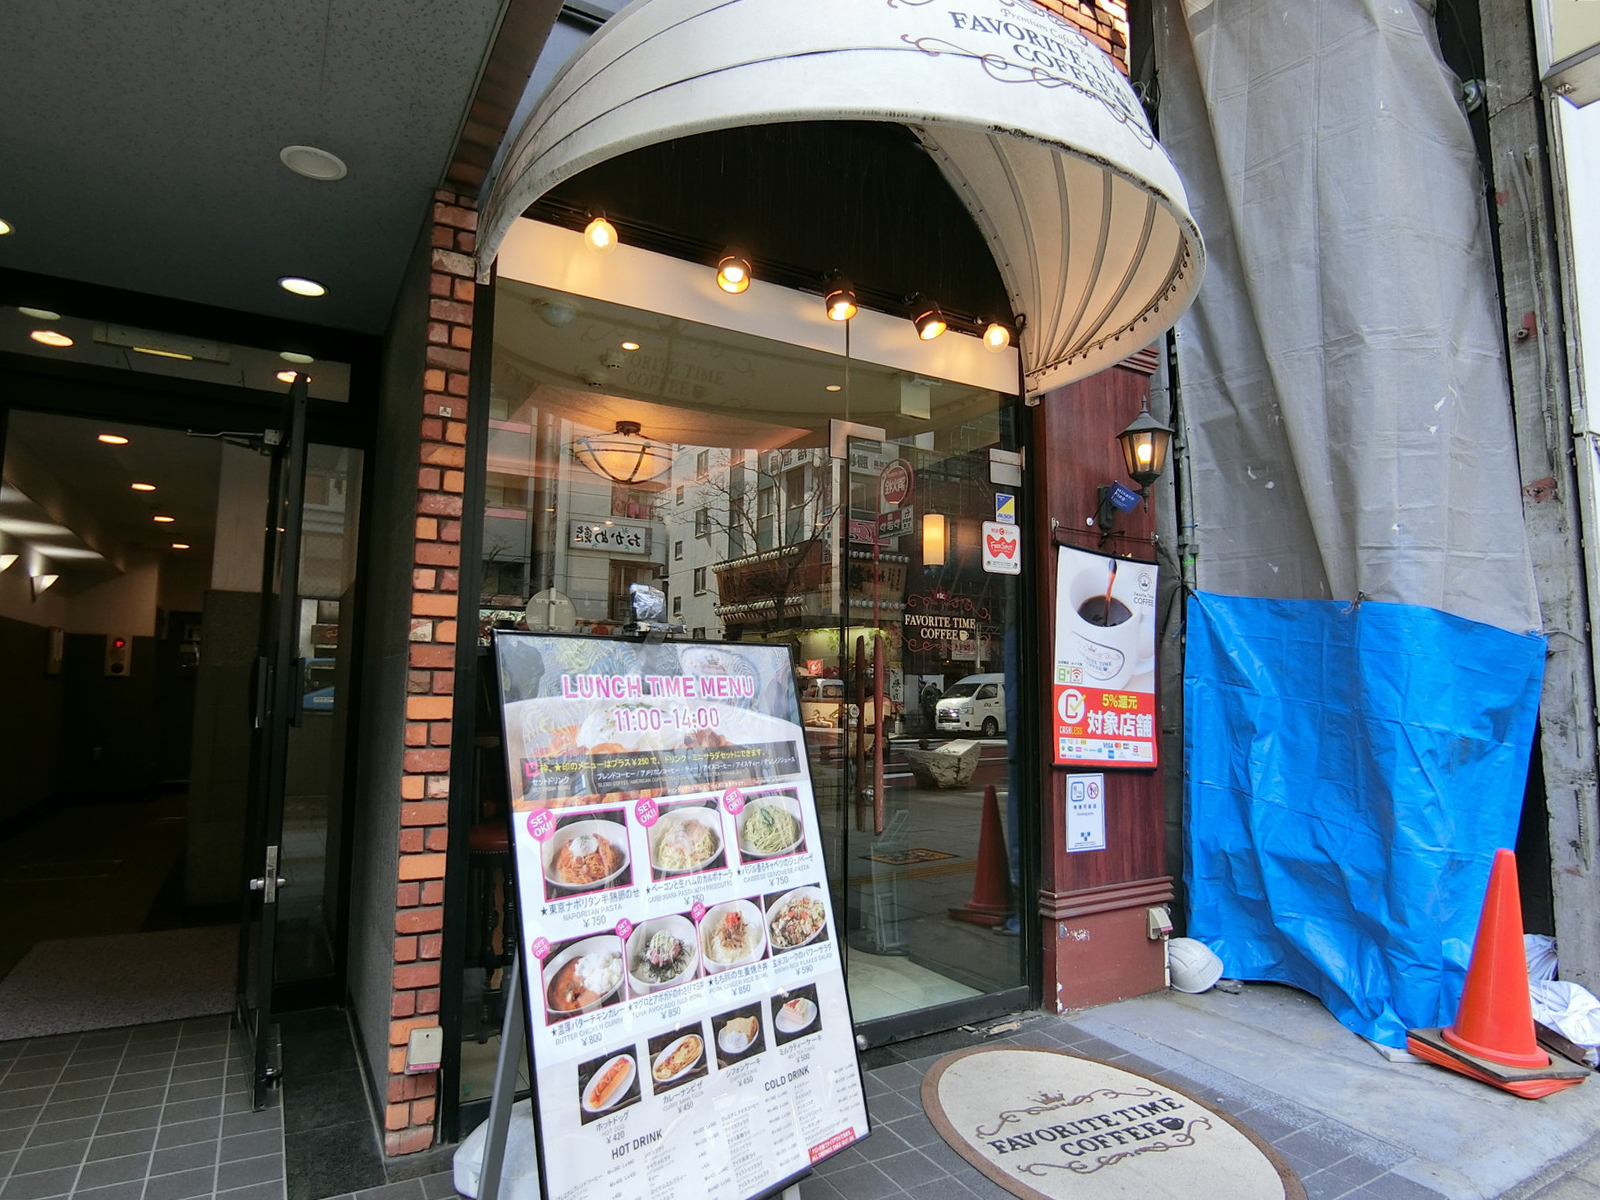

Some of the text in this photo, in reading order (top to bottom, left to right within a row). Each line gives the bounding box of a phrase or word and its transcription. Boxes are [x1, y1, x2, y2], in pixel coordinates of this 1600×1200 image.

[949, 11, 1086, 70] FAVORITE
[1013, 44, 1109, 97] COFFEE
[1134, 597, 1154, 607] COFFEE
[905, 614, 976, 630] FAVORITE TIME
[920, 627, 959, 640] COFFEE
[563, 675, 754, 698] LUNCH TIME MENU
[1102, 693, 1138, 709] 5%還元
[614, 707, 720, 732] 11:00-14:00
[1087, 710, 1153, 738] 対象店舗
[1060, 726, 1083, 735] CASHLESS
[725, 791, 738, 804] SET
[638, 800, 652, 814] SET
[531, 812, 547, 828] SET
[768, 875, 789, 887] ¥750
[601, 903, 623, 914] PASTA
[582, 915, 606, 928] ¥750
[795, 965, 813, 976] ¥590
[731, 985, 751, 997] ¥850
[660, 1007, 682, 1020] ¥850
[581, 1032, 603, 1047] ¥800
[779, 1034, 822, 1056] ミルクティーケーキ
[795, 1053, 810, 1064] ¥500
[725, 1057, 762, 1079] シフォンケーキ
[738, 1075, 754, 1087] ¥450
[764, 1064, 810, 1092] COLD DRINK
[663, 1081, 703, 1104] カレーナンピザ
[678, 1101, 694, 1114] ¥450
[596, 1110, 629, 1132] ホットドッグ
[987, 1097, 1185, 1155] FAVORITE TIME
[606, 1131, 625, 1145] ¥420
[612, 1142, 631, 1161] HOT
[633, 1128, 663, 1151] DRINK
[1060, 1122, 1166, 1156] COFFEE
